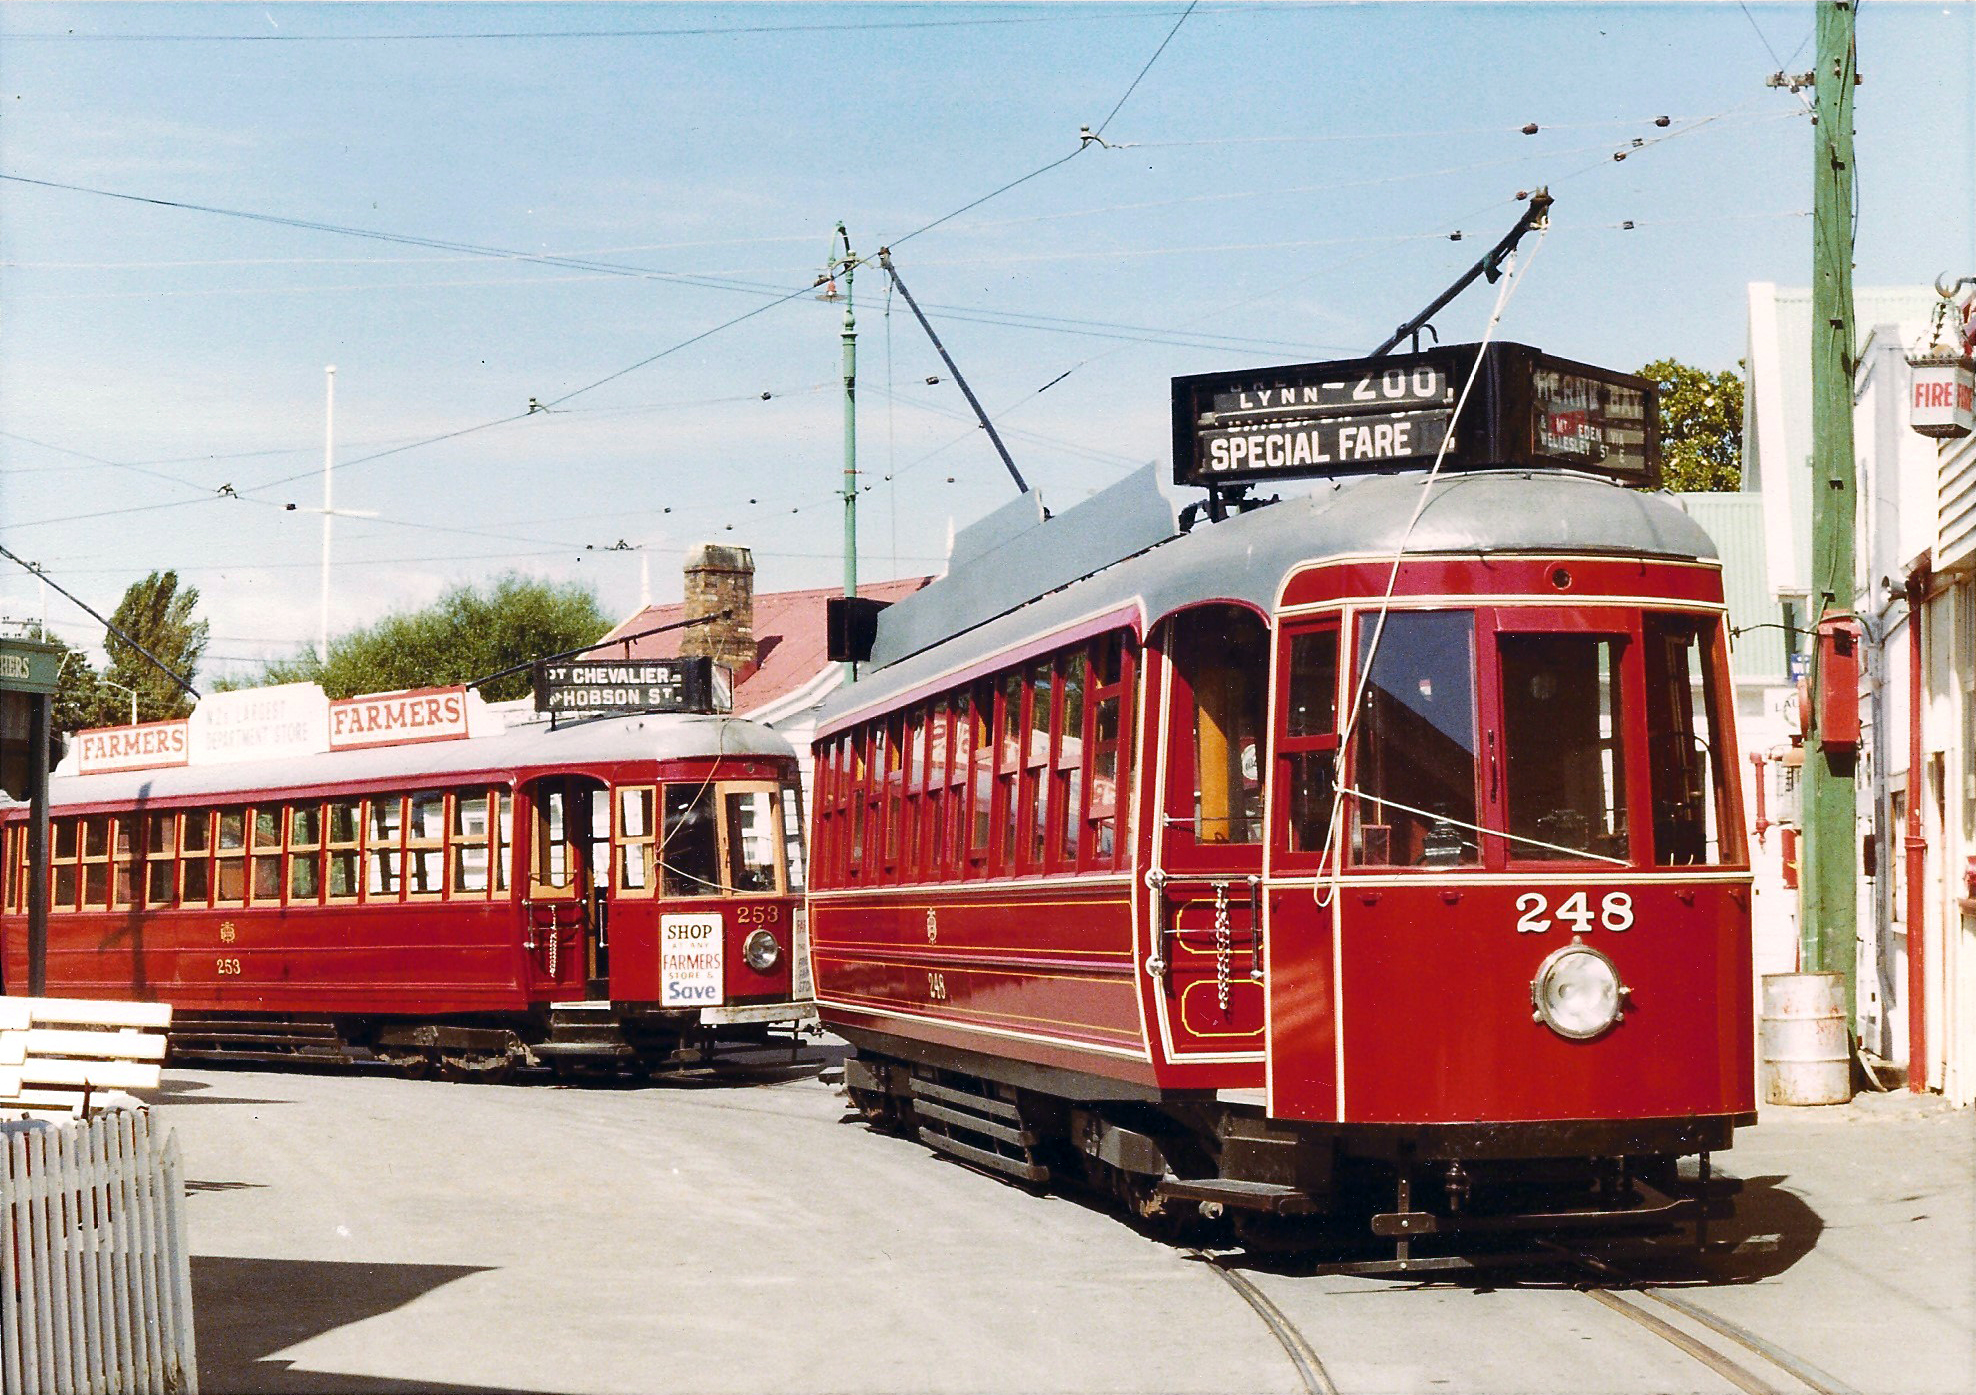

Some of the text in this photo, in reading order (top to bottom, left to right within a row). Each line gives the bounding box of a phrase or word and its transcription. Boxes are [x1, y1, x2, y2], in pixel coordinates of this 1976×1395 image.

[1240, 387, 1318, 409] LYNN
[1915, 382, 1953, 408] FIRE
[1578, 424, 1602, 443] EDEN
[1211, 422, 1412, 471] SPECIAL FARE
[1540, 431, 1591, 456] WELLESLEY
[572, 667, 669, 684] CHEVALIER
[563, 689, 640, 707] HOBSON
[334, 697, 460, 735] FARMERS
[83, 729, 184, 760] FARMERS
[737, 906, 779, 924] 253
[1516, 891, 1634, 932] 248
[667, 925, 713, 940] SHOP
[216, 958, 241, 975] 253
[663, 954, 721, 971] FARMERS
[669, 972, 700, 980] STORE
[928, 972, 946, 999] 248
[668, 981, 717, 1000] Save
